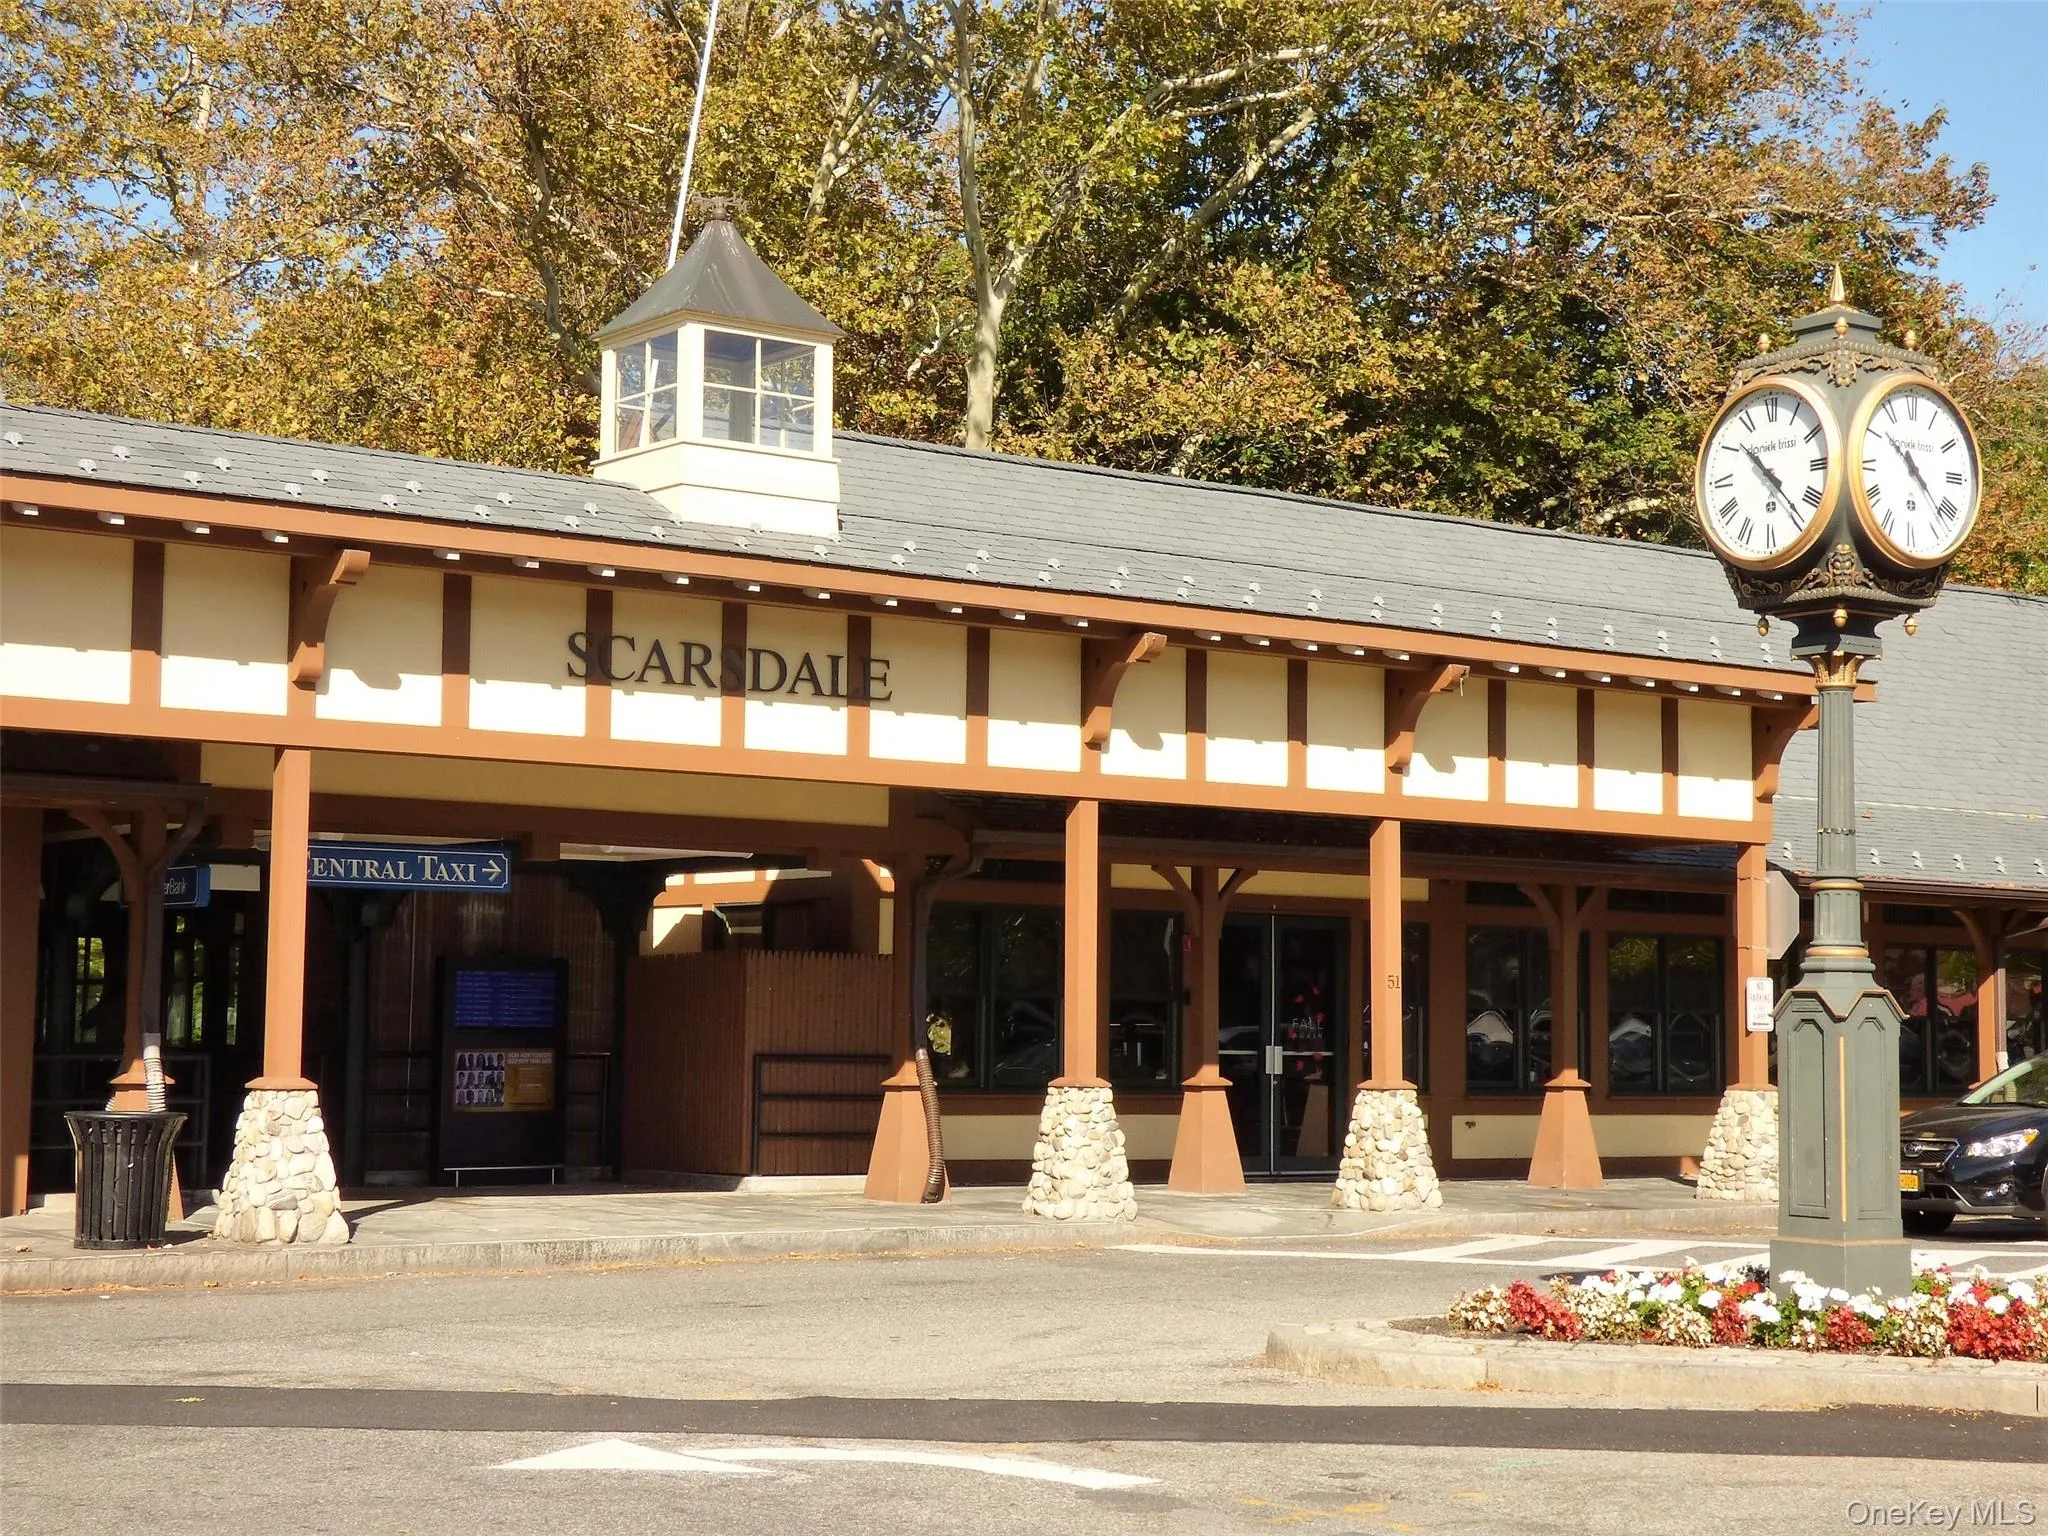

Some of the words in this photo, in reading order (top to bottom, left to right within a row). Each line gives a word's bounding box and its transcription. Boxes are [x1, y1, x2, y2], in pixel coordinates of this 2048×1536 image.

[567, 631, 893, 702] SCARSDALE
[307, 851, 413, 880] ENTRAL
[164, 877, 188, 896] erBank
[1387, 974, 1401, 989] 51
